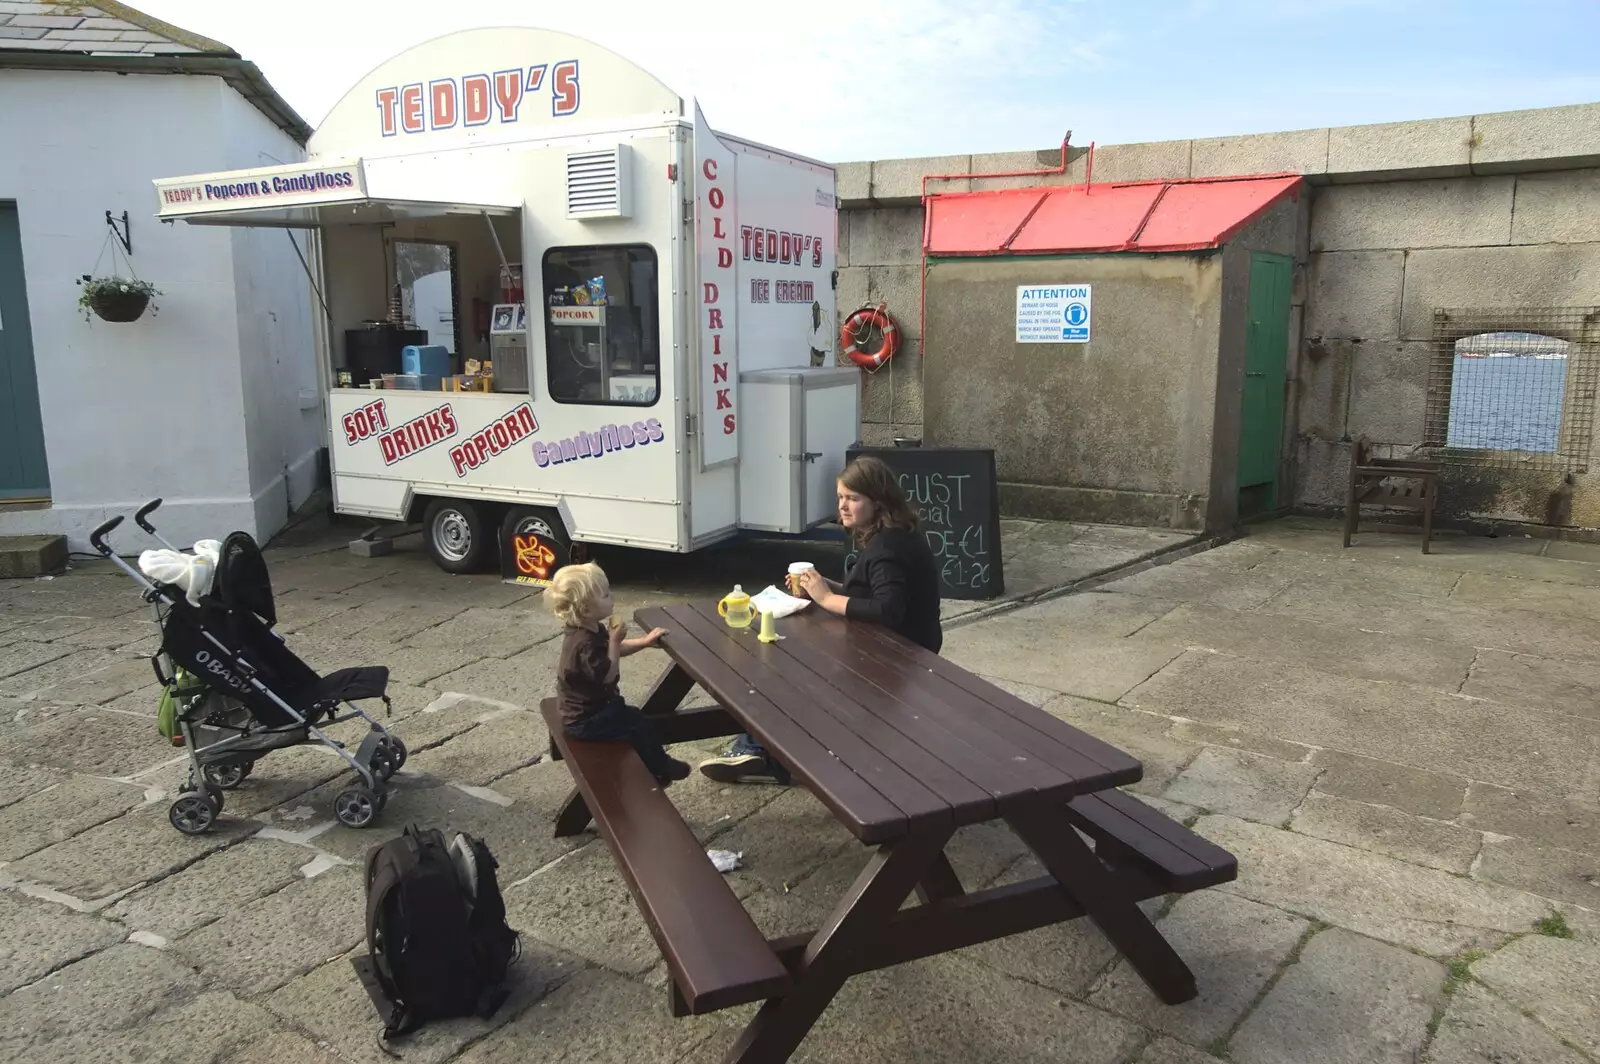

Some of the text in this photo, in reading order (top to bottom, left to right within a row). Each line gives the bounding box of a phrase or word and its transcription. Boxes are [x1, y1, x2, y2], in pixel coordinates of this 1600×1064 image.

[376, 59, 580, 137] TEDDY'S
[163, 170, 354, 203] TEDDY'S Popcorn & Candyfloss
[741, 225, 822, 268] TEDDY'S
[703, 158, 736, 435] COLD DRINKS
[751, 278, 814, 304] ICE CREAM
[1022, 288, 1087, 299] ATTENTION
[552, 310, 595, 319] POPCORN
[342, 397, 390, 446] SOFT
[377, 402, 458, 466] DRINKS
[448, 402, 540, 478] POPCORN
[532, 418, 664, 468] Candyfloss
[899, 473, 971, 511] GUST
[918, 503, 952, 527] cial
